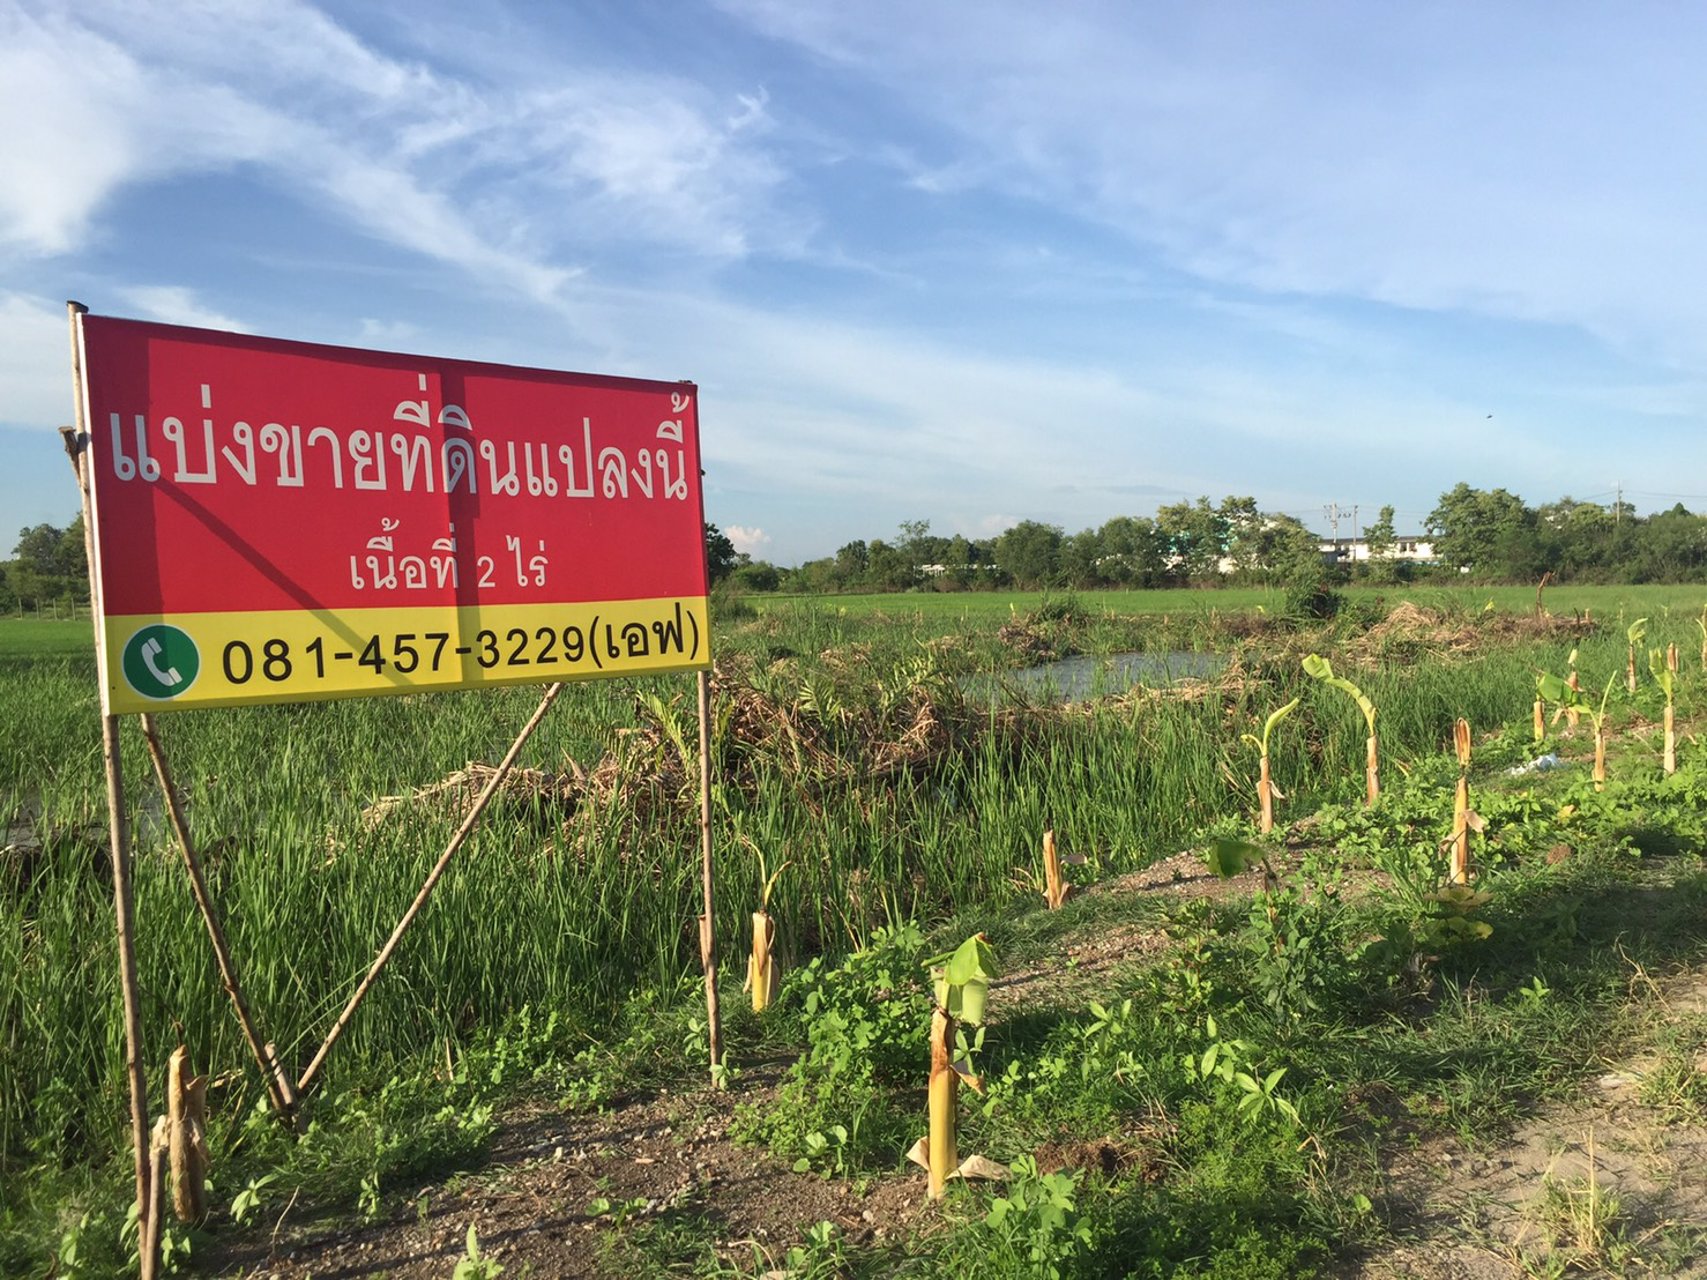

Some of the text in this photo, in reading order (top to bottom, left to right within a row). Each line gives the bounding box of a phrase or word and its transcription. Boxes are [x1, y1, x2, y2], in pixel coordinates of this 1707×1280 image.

[110, 373, 690, 500] แบ่งขายที่ดินแปลงนี้
[350, 517, 549, 589] เนื้อที่ 2 ไร่
